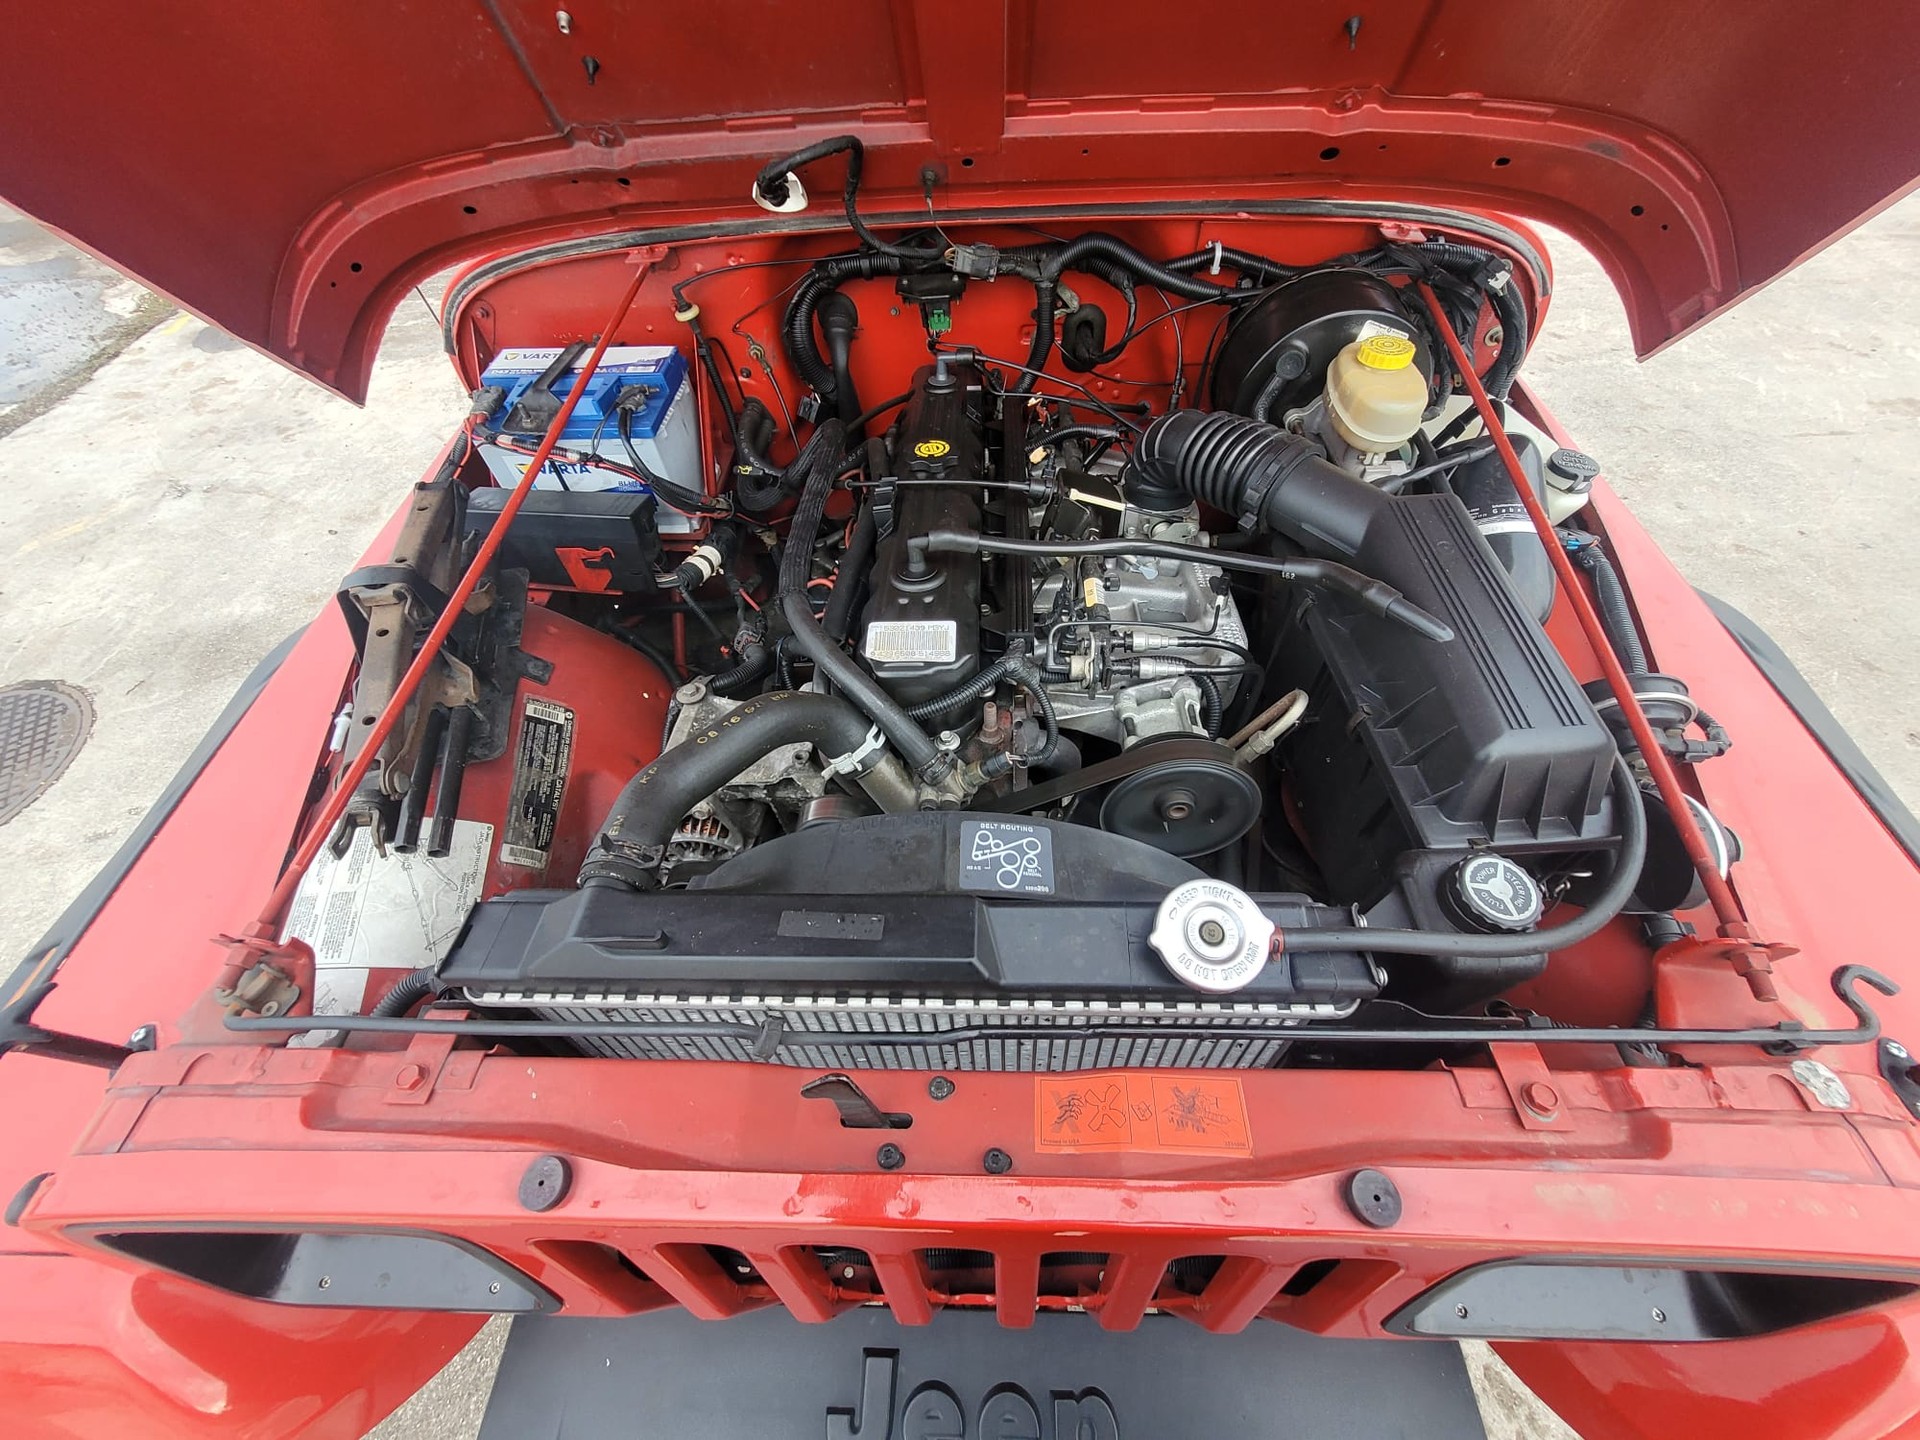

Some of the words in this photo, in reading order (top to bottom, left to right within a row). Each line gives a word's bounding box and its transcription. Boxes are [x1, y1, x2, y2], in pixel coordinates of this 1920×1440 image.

[551, 779, 563, 811] CATALYST
[1000, 824, 1033, 832] ROUTING
[1475, 866, 1495, 882] POWER
[1202, 886, 1234, 902] TIGHT
[1505, 872, 1526, 907] STEERING
[1481, 891, 1504, 910] FLUID
[1177, 952, 1194, 970] DO
[1194, 963, 1218, 980] NOT
[1221, 960, 1248, 981] OPEN
